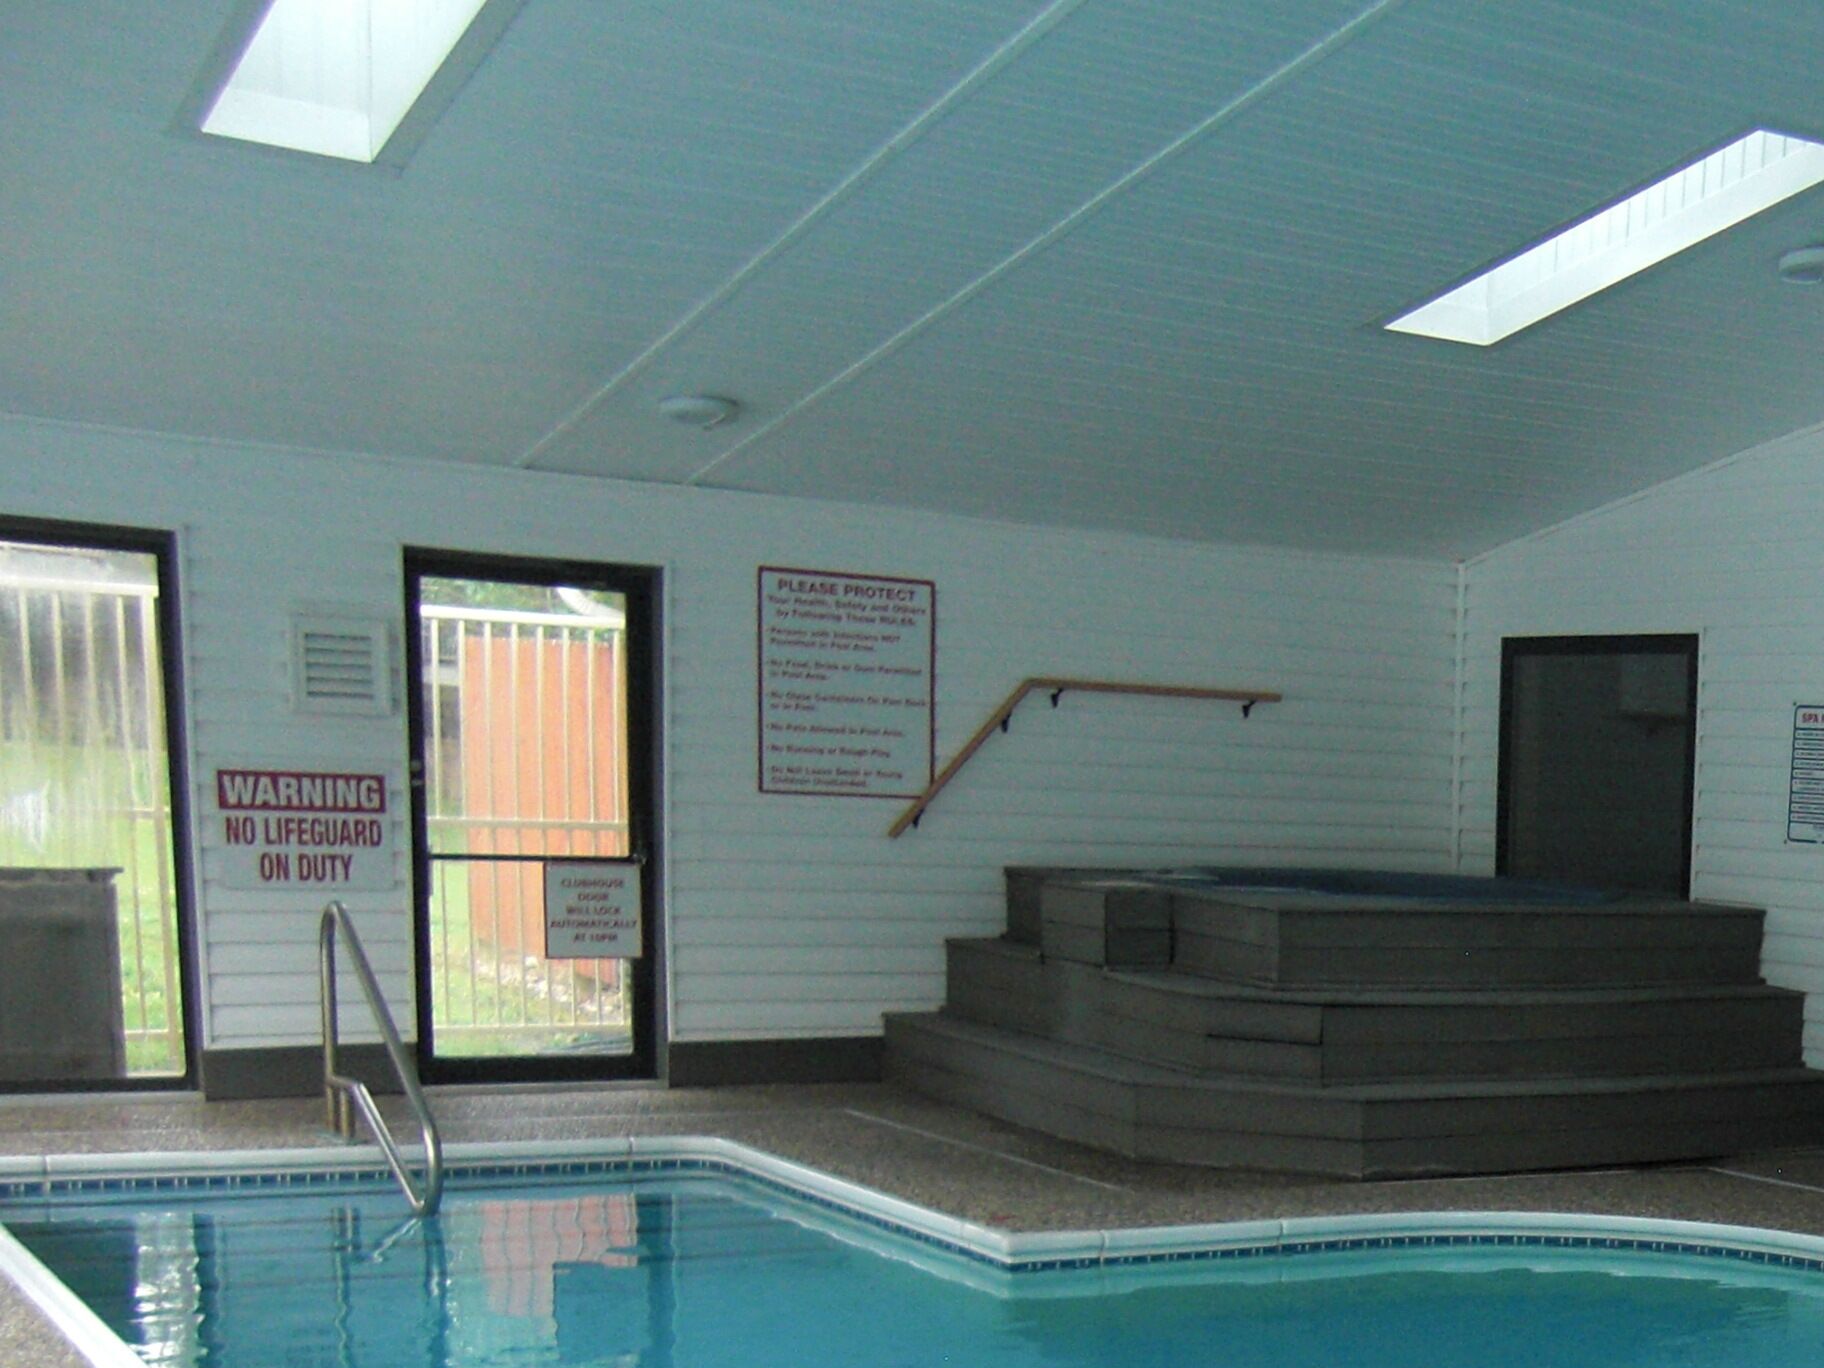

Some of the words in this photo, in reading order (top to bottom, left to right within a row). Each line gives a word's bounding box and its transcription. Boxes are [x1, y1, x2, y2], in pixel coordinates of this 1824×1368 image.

[778, 578, 838, 595] PLEASE
[844, 583, 915, 601] PROTECT
[835, 601, 867, 611] Safety
[776, 609, 789, 619] by
[1802, 713, 1818, 724] SPA
[223, 775, 380, 809] WARNING
[225, 816, 256, 845] NO
[264, 818, 382, 846] LIFEGUARD
[261, 852, 290, 881] ON
[298, 853, 353, 882] DUTY
[561, 878, 624, 888] CLUBHOUSE
[578, 893, 609, 901] DOOR
[566, 906, 589, 914] WILL
[595, 906, 620, 915] LOCK
[551, 920, 636, 928] AUTOMATICALLY
[574, 933, 586, 942] AT
[591, 933, 618, 942] 10PM
